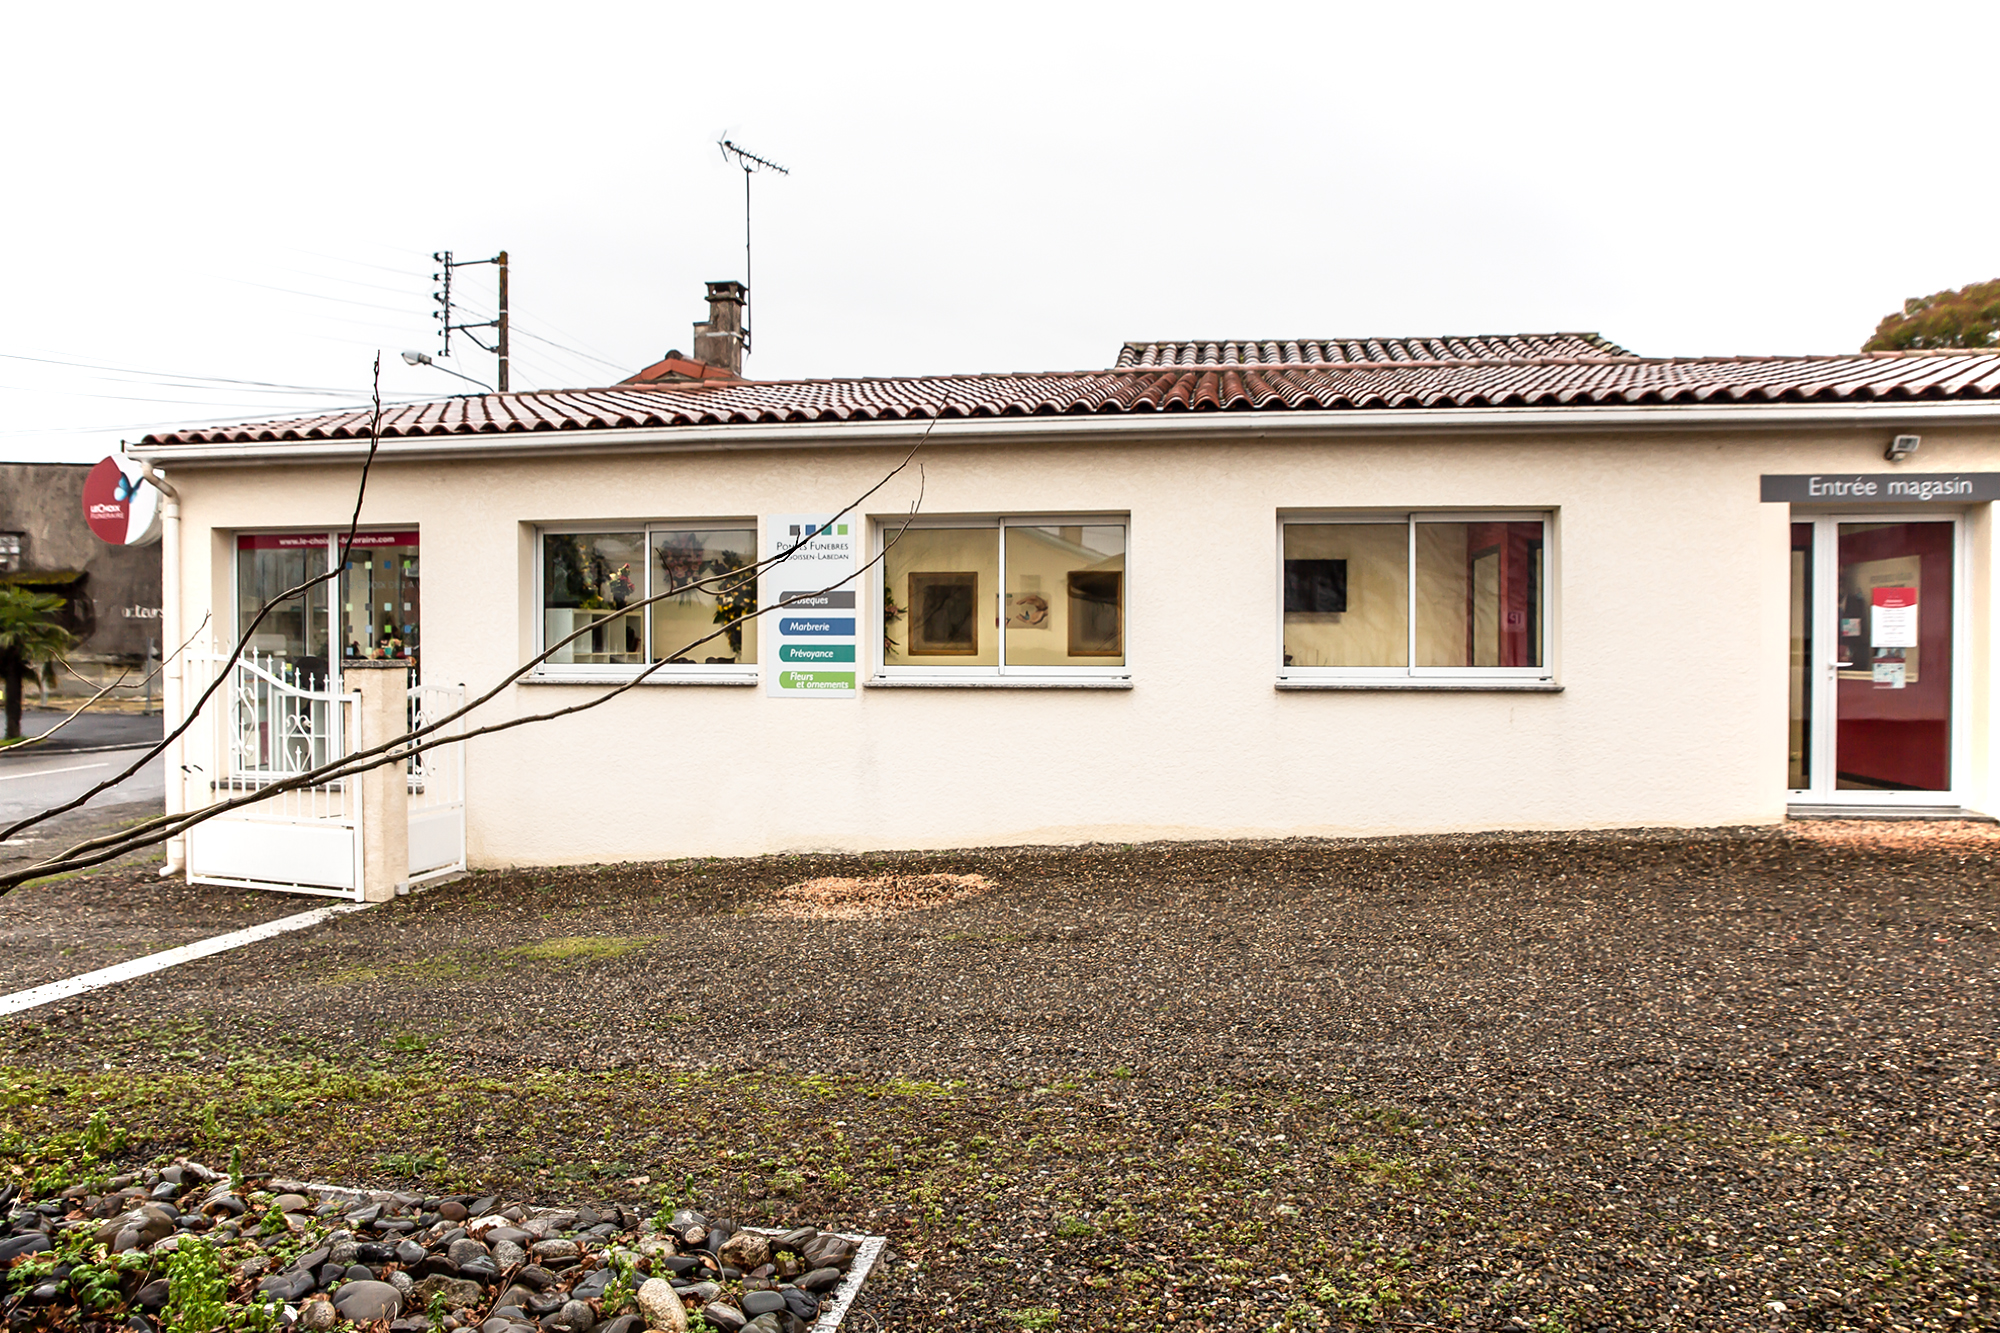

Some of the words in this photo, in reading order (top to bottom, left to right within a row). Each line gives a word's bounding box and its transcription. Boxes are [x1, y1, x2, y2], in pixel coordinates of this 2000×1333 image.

[1808, 476, 1878, 496] Entrée
[1887, 476, 1973, 501] magasin
[776, 541, 808, 551] POES
[810, 541, 849, 551] FUNEBRES
[790, 621, 830, 631] Marbrerie
[790, 648, 834, 660] Prévoyance
[790, 671, 814, 681] Fleurs
[796, 680, 805, 688] et
[806, 681, 849, 689] ornements
